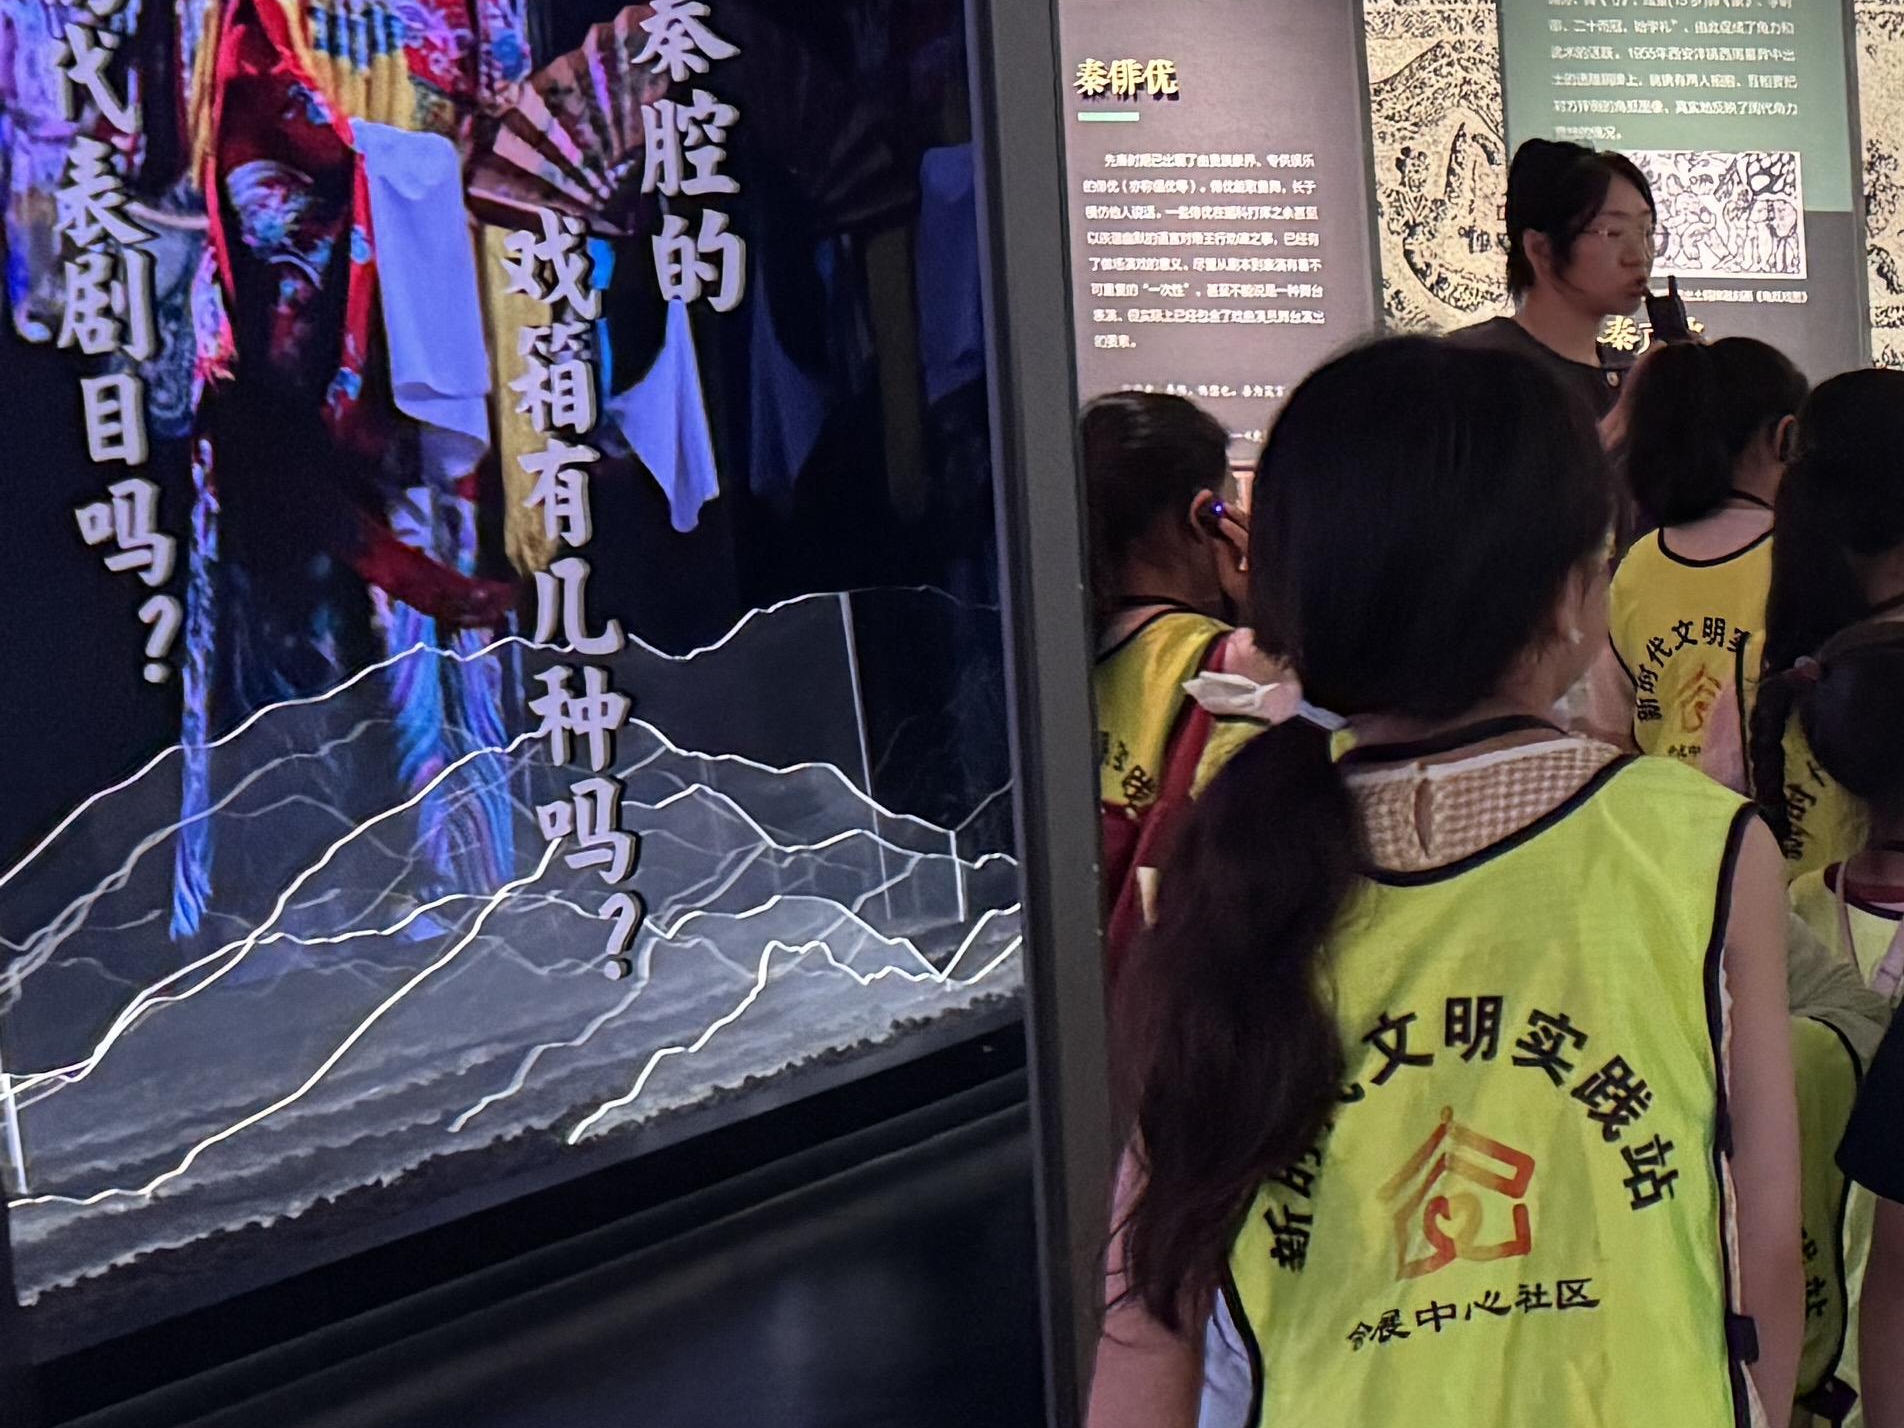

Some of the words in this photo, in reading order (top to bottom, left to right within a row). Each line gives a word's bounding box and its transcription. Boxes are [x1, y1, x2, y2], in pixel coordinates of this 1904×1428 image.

[1073, 58, 1179, 97] 秦俳优
[500, 208, 650, 985] 戏箱有几种吗？
